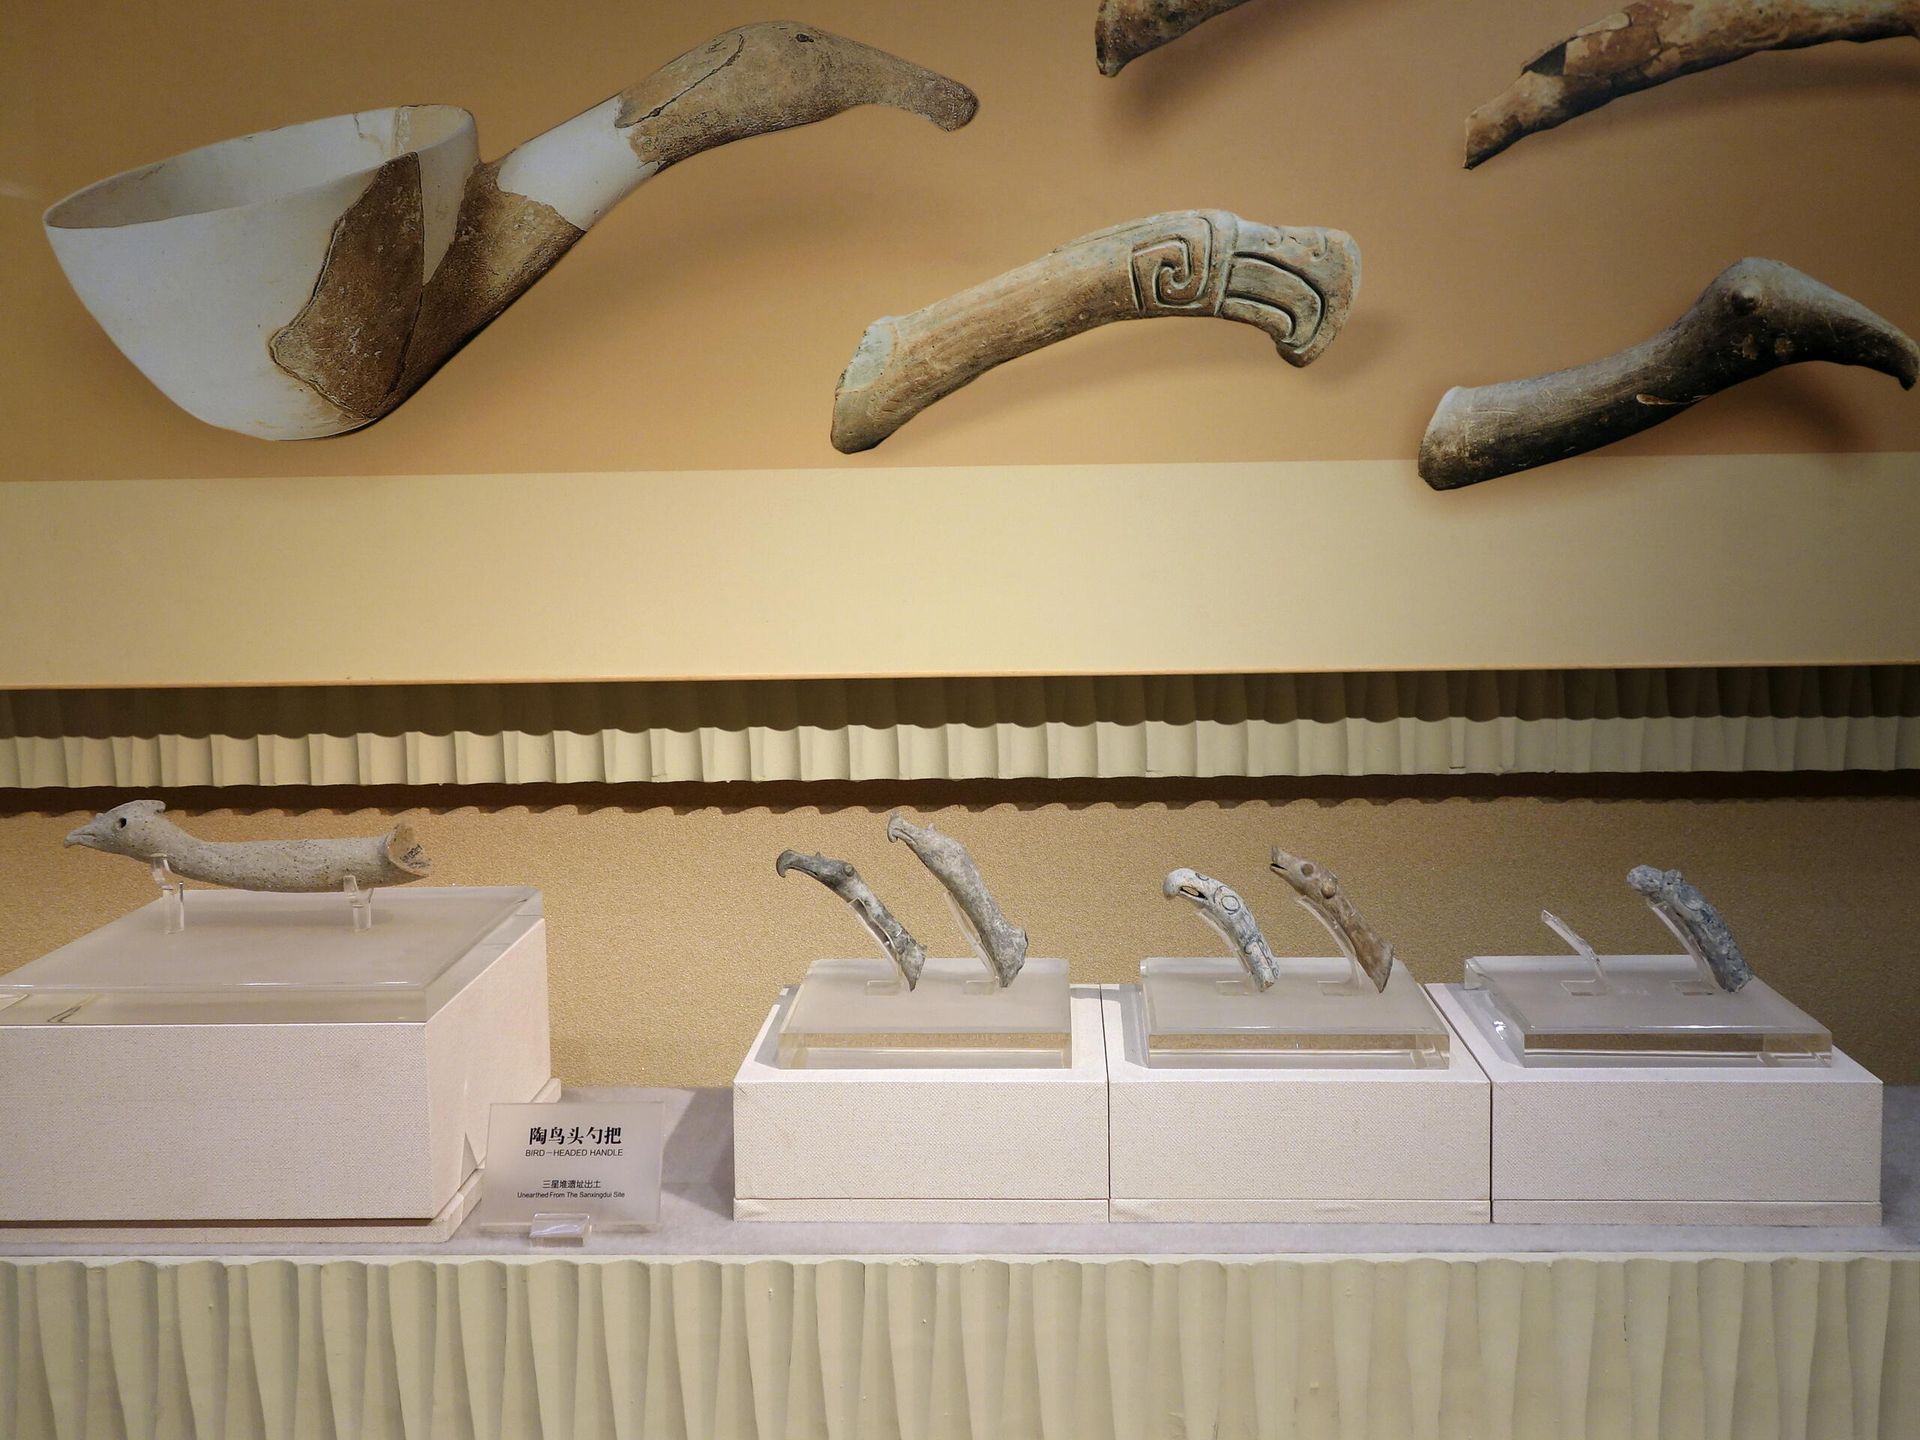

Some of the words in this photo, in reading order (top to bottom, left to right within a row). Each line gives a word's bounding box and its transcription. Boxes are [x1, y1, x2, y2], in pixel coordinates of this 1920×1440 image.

[529, 1126, 622, 1146] 陶鸟头勺把
[589, 1149, 623, 1157] HANDLE
[542, 1180, 601, 1189] 三星堆遗址出土
[517, 1191, 549, 1199] Unearthed
[549, 1191, 565, 1199] From
[567, 1191, 578, 1199] The
[579, 1191, 612, 1200] Sanxingdui
[613, 1191, 625, 1199] Site
